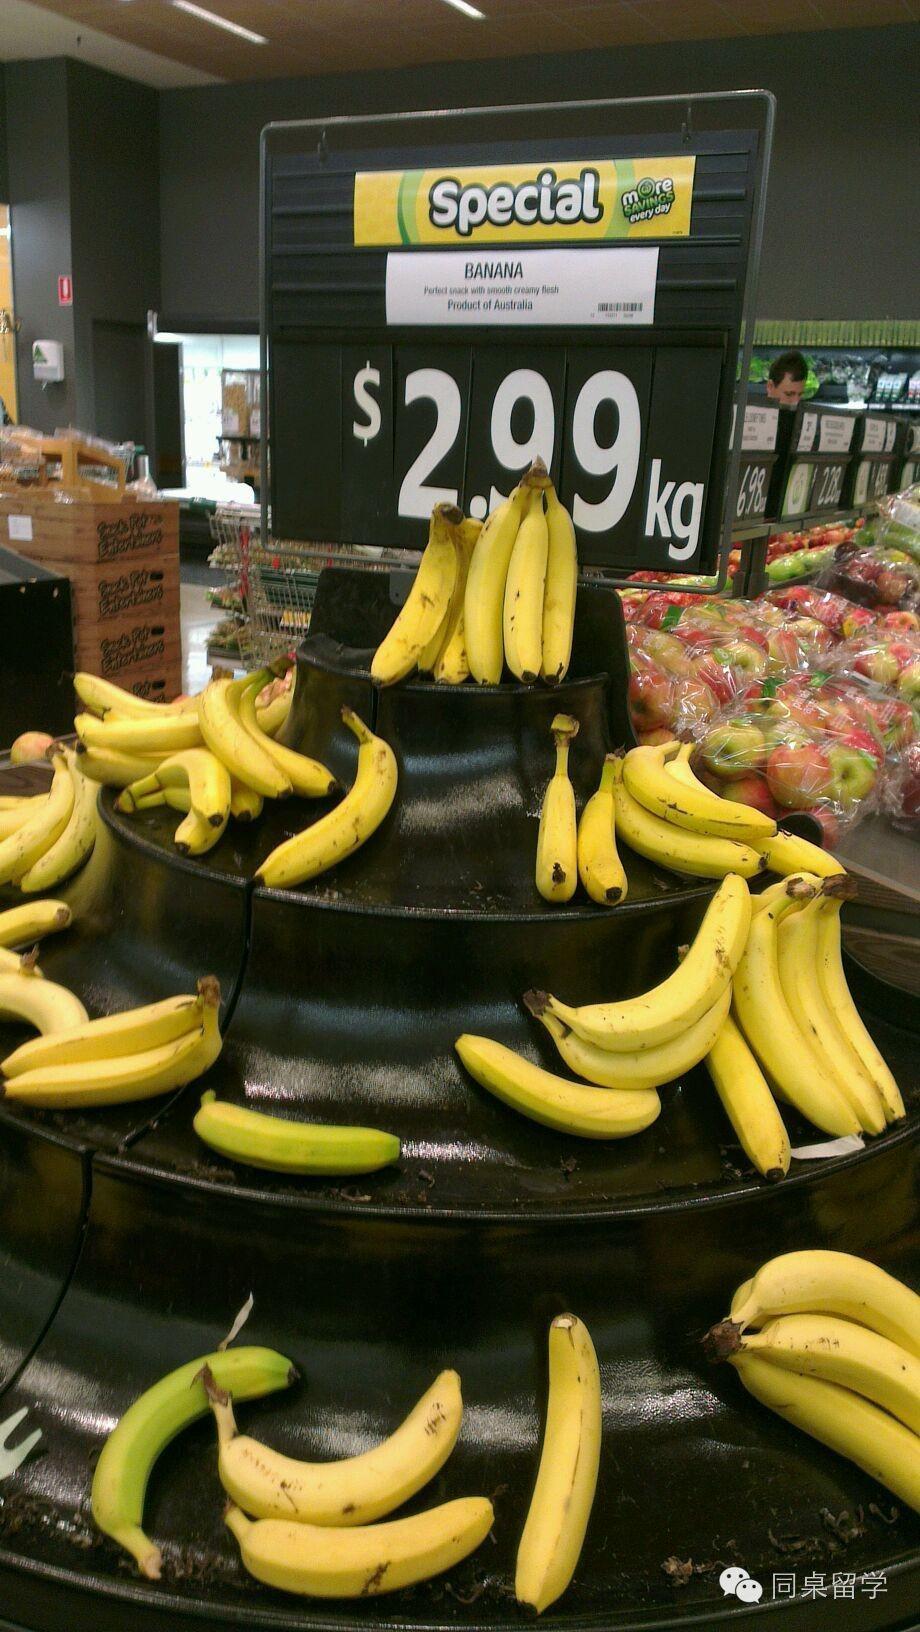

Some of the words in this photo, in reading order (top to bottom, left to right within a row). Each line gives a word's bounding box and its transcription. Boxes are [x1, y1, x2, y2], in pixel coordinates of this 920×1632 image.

[430, 168, 602, 235] Special
[622, 177, 673, 206] more
[624, 190, 674, 216] SAVINGS
[630, 208, 654, 223] every
[654, 202, 671, 214] day
[464, 261, 524, 279] BANANA
[424, 285, 448, 295] Perfect
[449, 285, 469, 295] snack
[470, 285, 485, 295] with
[487, 285, 513, 295] smooth
[513, 286, 540, 296] creamy
[541, 284, 560, 295] flesh
[447, 298, 481, 311] Product
[482, 299, 492, 310] of
[493, 298, 534, 311] Australia
[644, 458, 705, 562] kg
